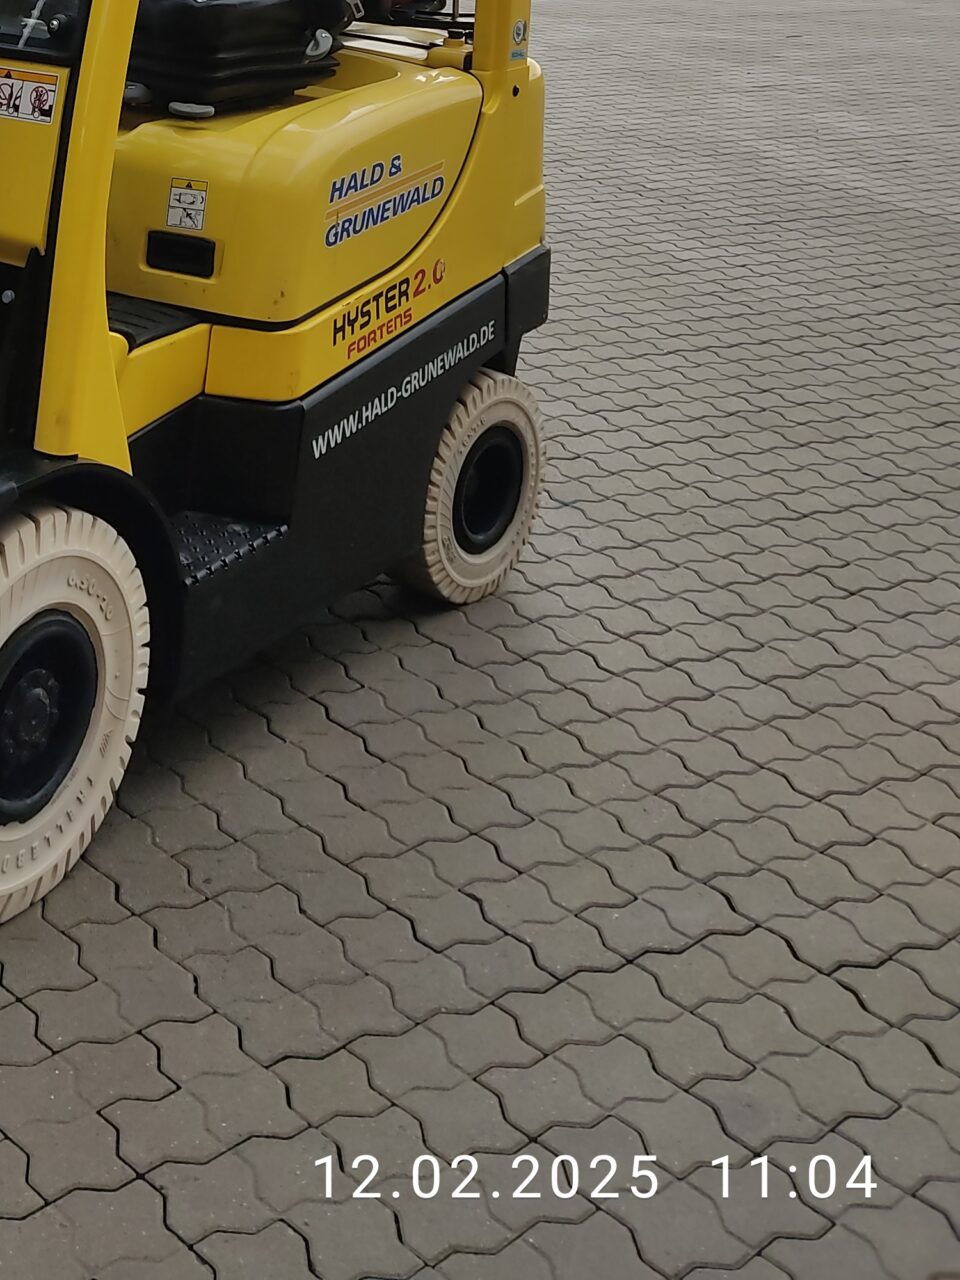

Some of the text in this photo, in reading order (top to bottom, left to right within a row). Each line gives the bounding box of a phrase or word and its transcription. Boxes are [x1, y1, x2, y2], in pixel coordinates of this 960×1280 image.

[325, 176, 445, 248] GRUNEWALD
[329, 154, 402, 204] HALD &
[332, 257, 446, 347] HYSTER 2.0
[346, 306, 414, 360] FORTENS
[311, 319, 496, 460] WWW.HALD-GRUNEWALD.DE
